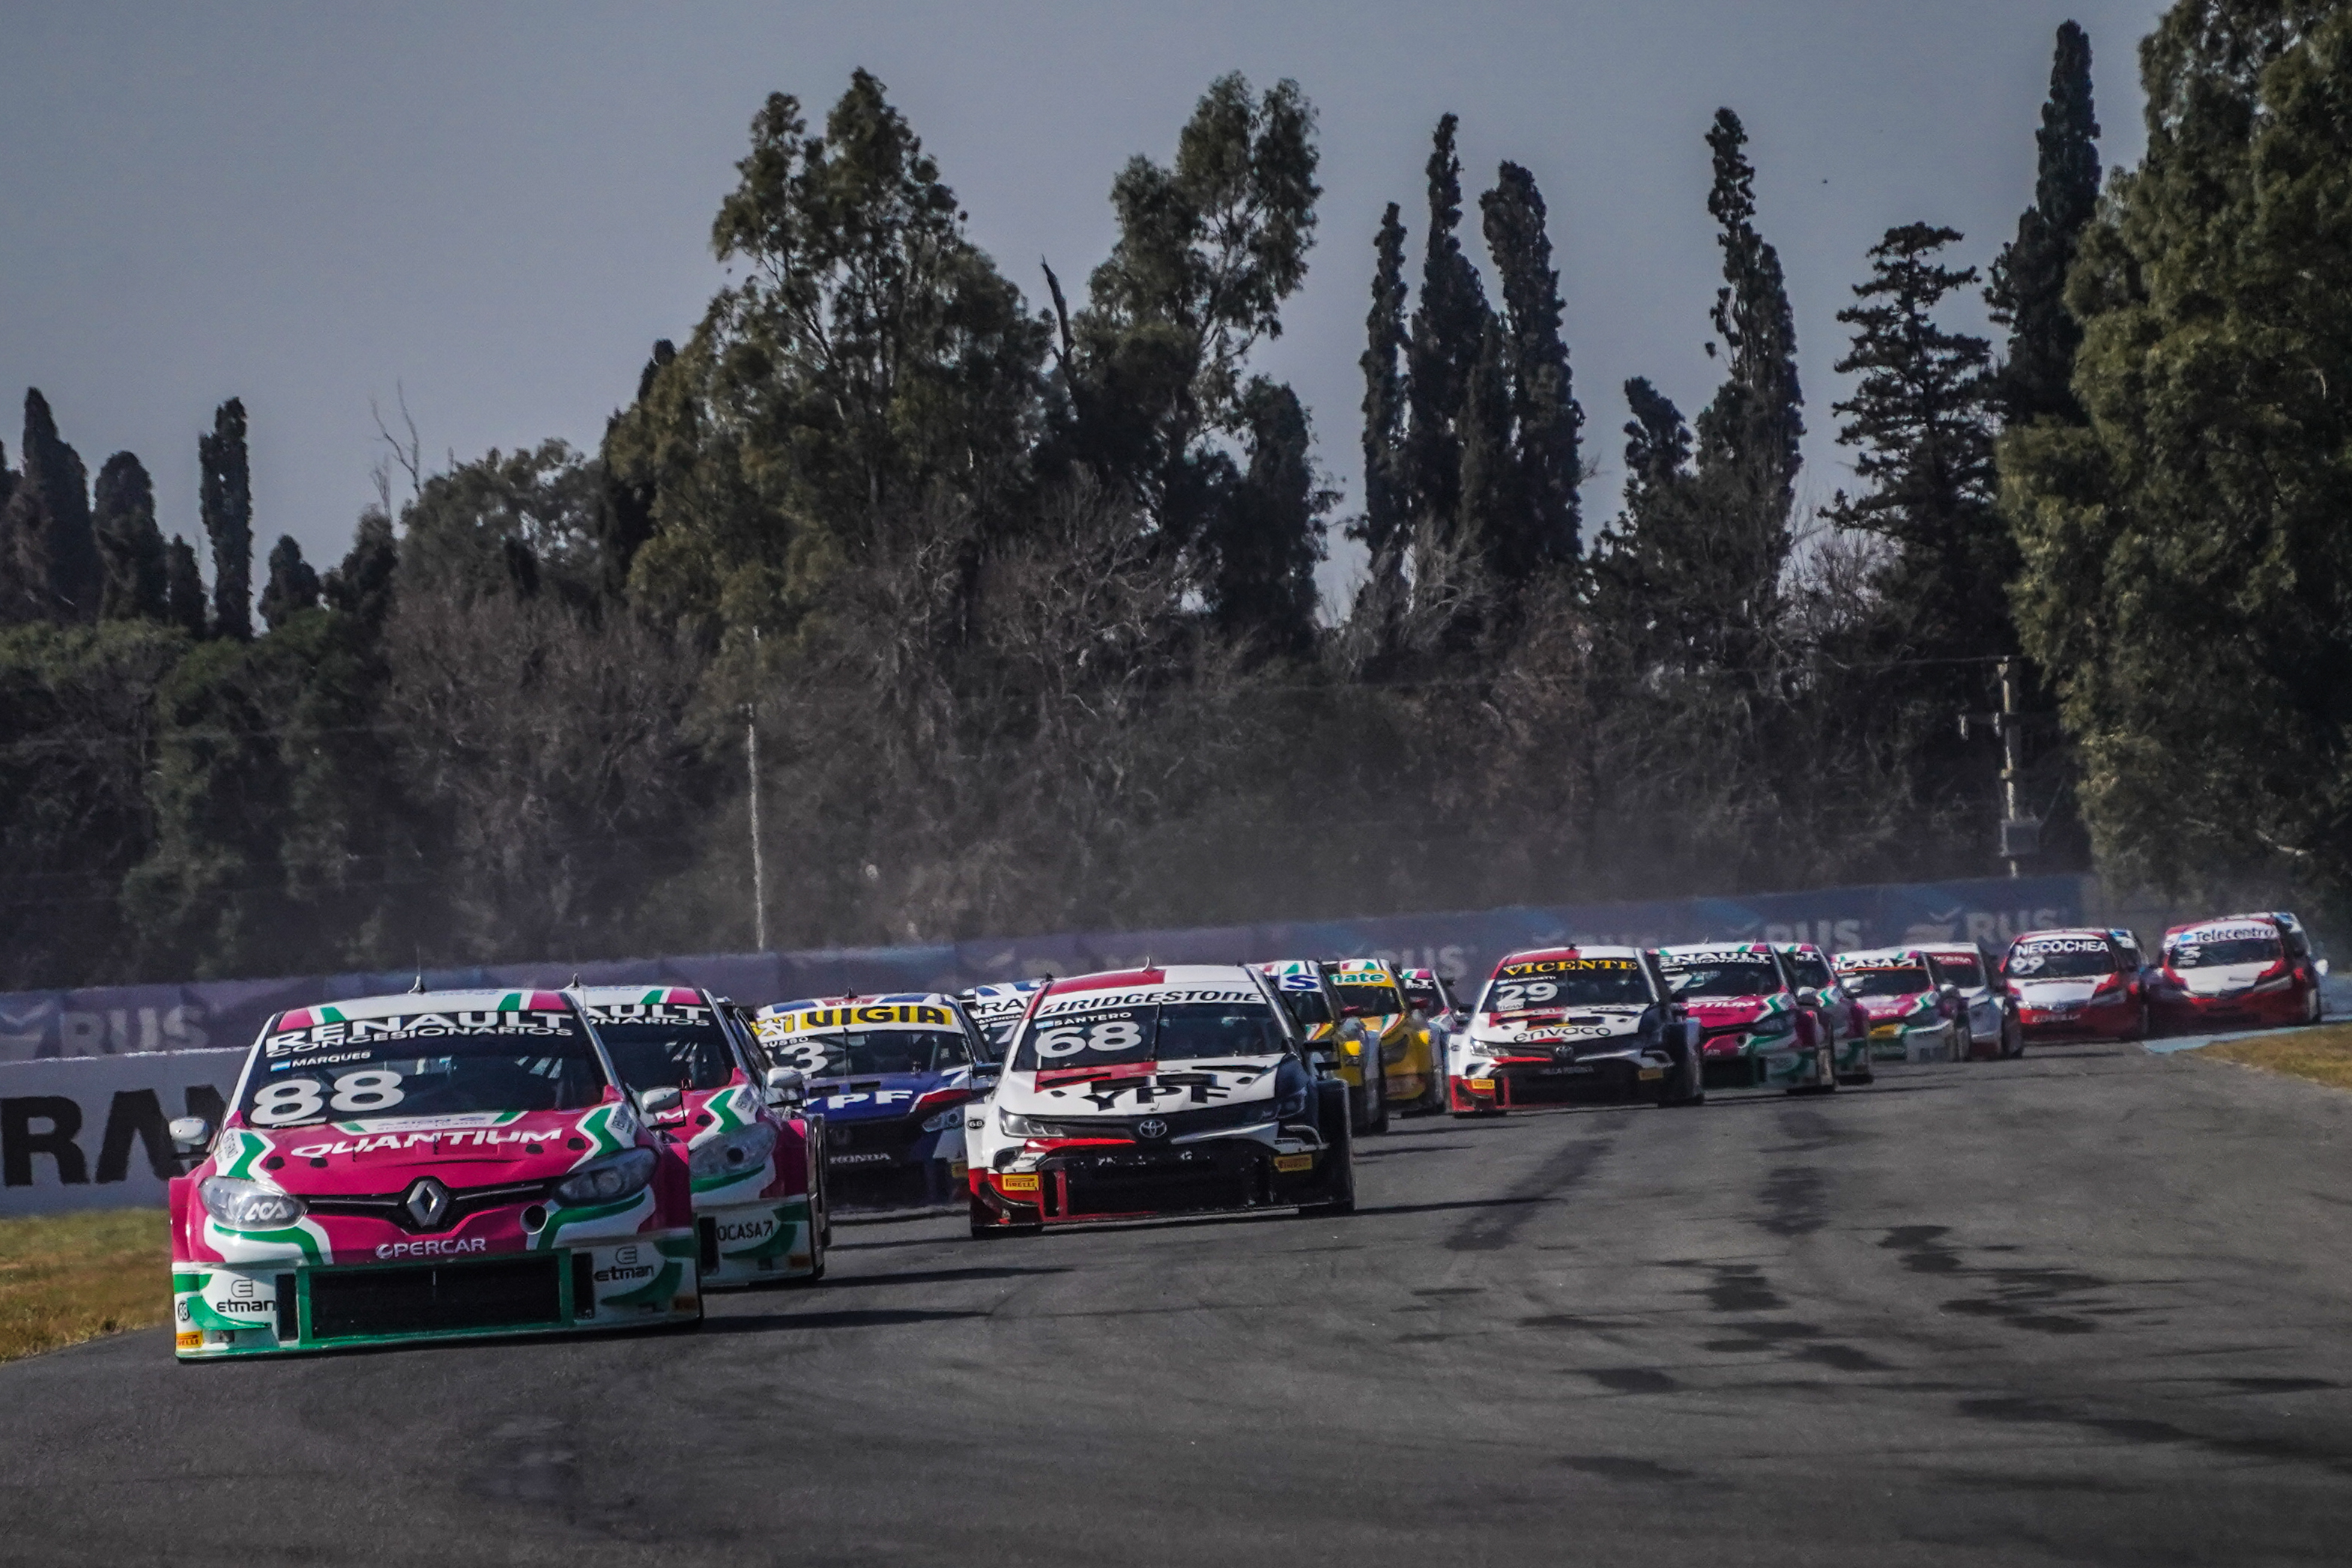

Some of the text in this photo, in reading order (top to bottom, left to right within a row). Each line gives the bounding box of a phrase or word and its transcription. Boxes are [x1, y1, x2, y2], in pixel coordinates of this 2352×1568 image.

[2015, 940, 2109, 957] NECOCHEA
[1505, 960, 1638, 975] VICENTE
[2008, 956, 2046, 974] 99
[1041, 990, 1265, 1014] BRIDGESTONE
[1496, 981, 1544, 1004] 29
[1053, 1011, 1132, 1027] SANTERO
[265, 1011, 574, 1052] RENAULT
[1034, 1020, 1143, 1058] 68
[1513, 1026, 1612, 1043] envaco
[266, 1026, 574, 1059] CONCESIONARIOS
[292, 1050, 372, 1068] MARQUES
[250, 1070, 407, 1125] 88
[1083, 1084, 1232, 1112] YPF
[290, 1127, 564, 1158] QUANTIUM
[717, 1222, 763, 1242] OCASA
[594, 1264, 654, 1282] etman
[216, 1298, 276, 1313] etman
